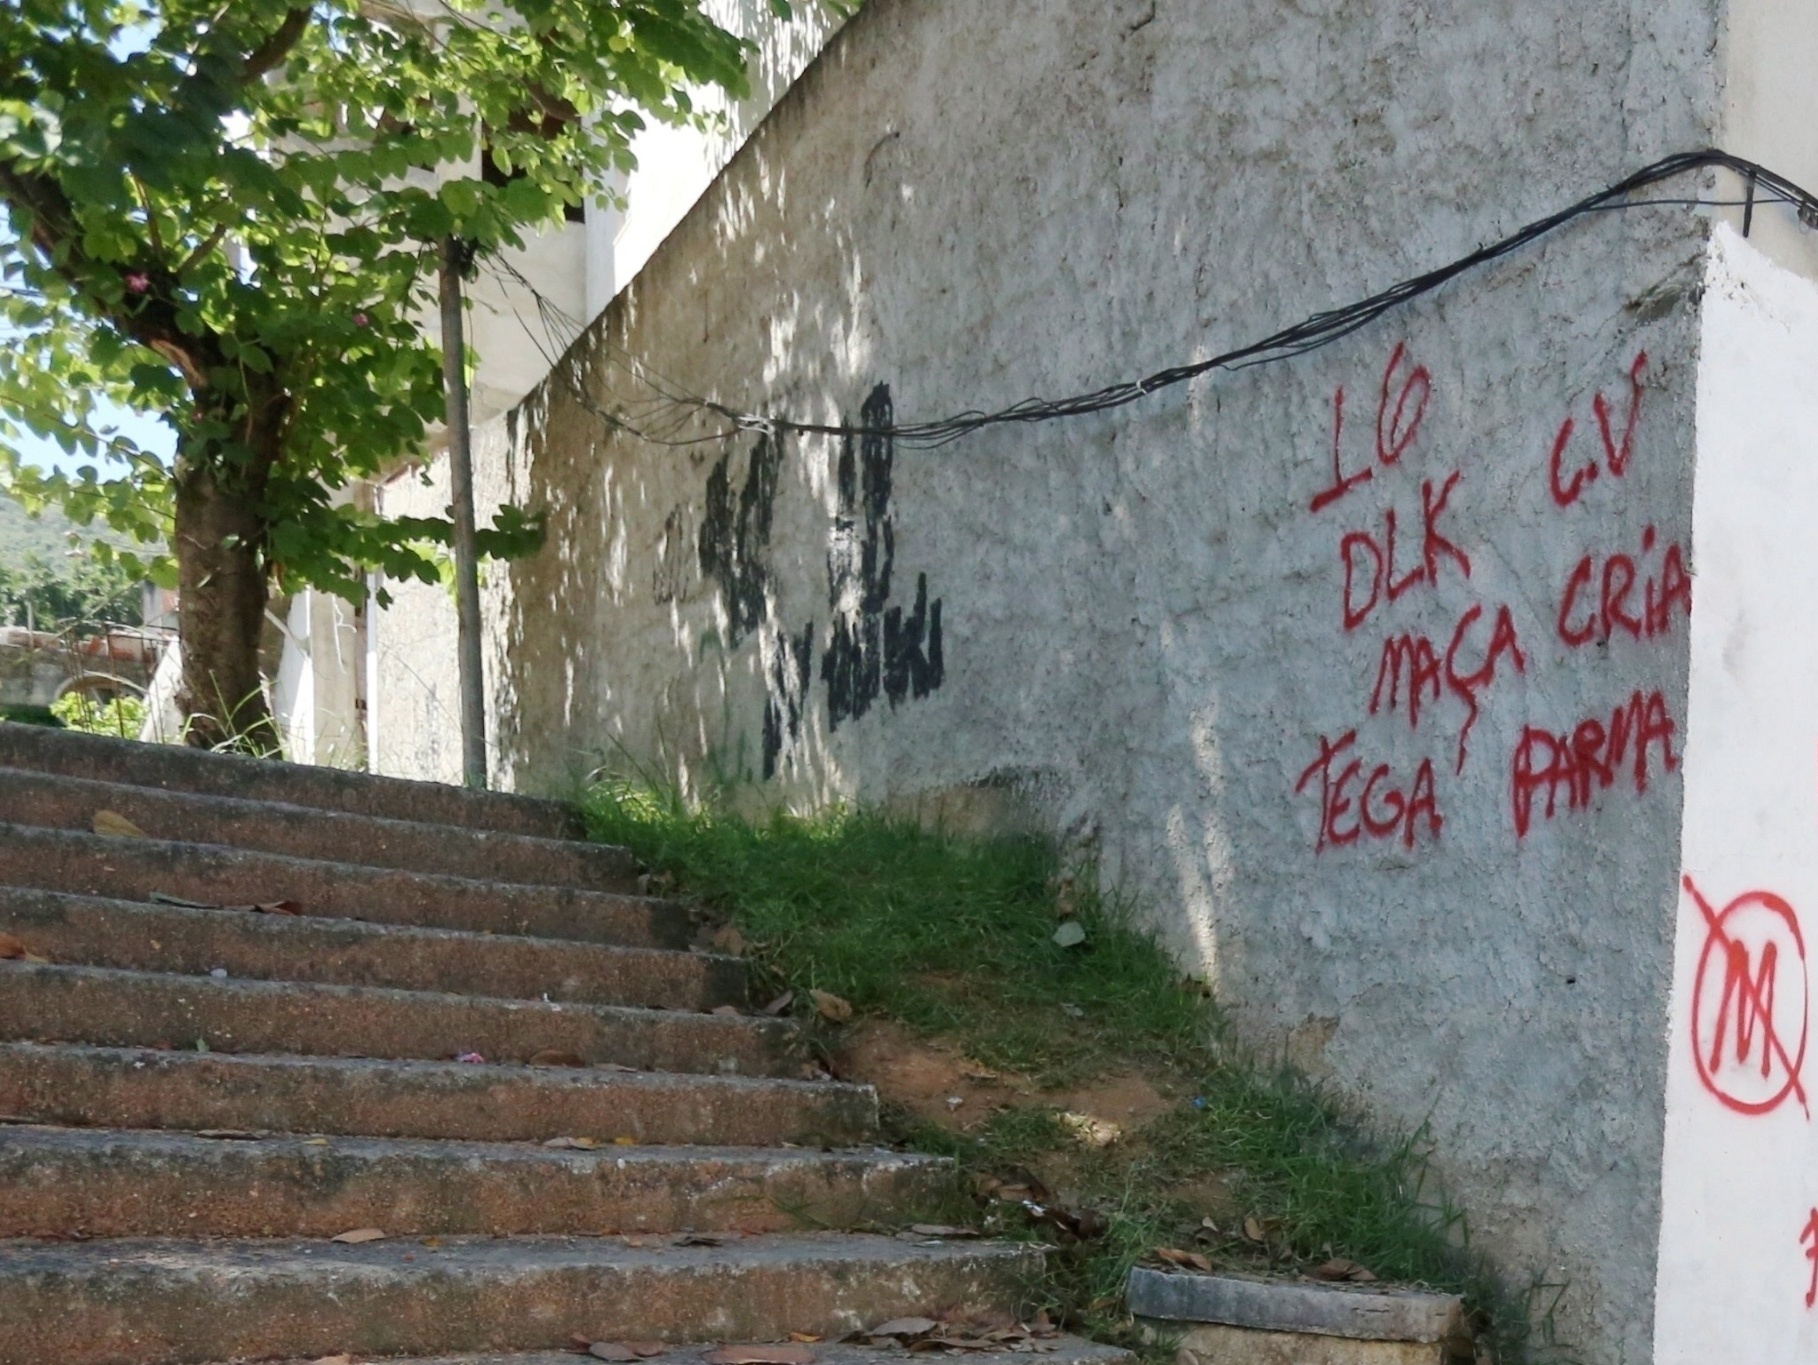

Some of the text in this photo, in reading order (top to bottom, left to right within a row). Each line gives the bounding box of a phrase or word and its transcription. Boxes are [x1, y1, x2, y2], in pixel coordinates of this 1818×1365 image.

[1340, 470, 1470, 633] DLK
[1558, 526, 1692, 648] CRIA
[1296, 729, 1443, 855] TEGA
